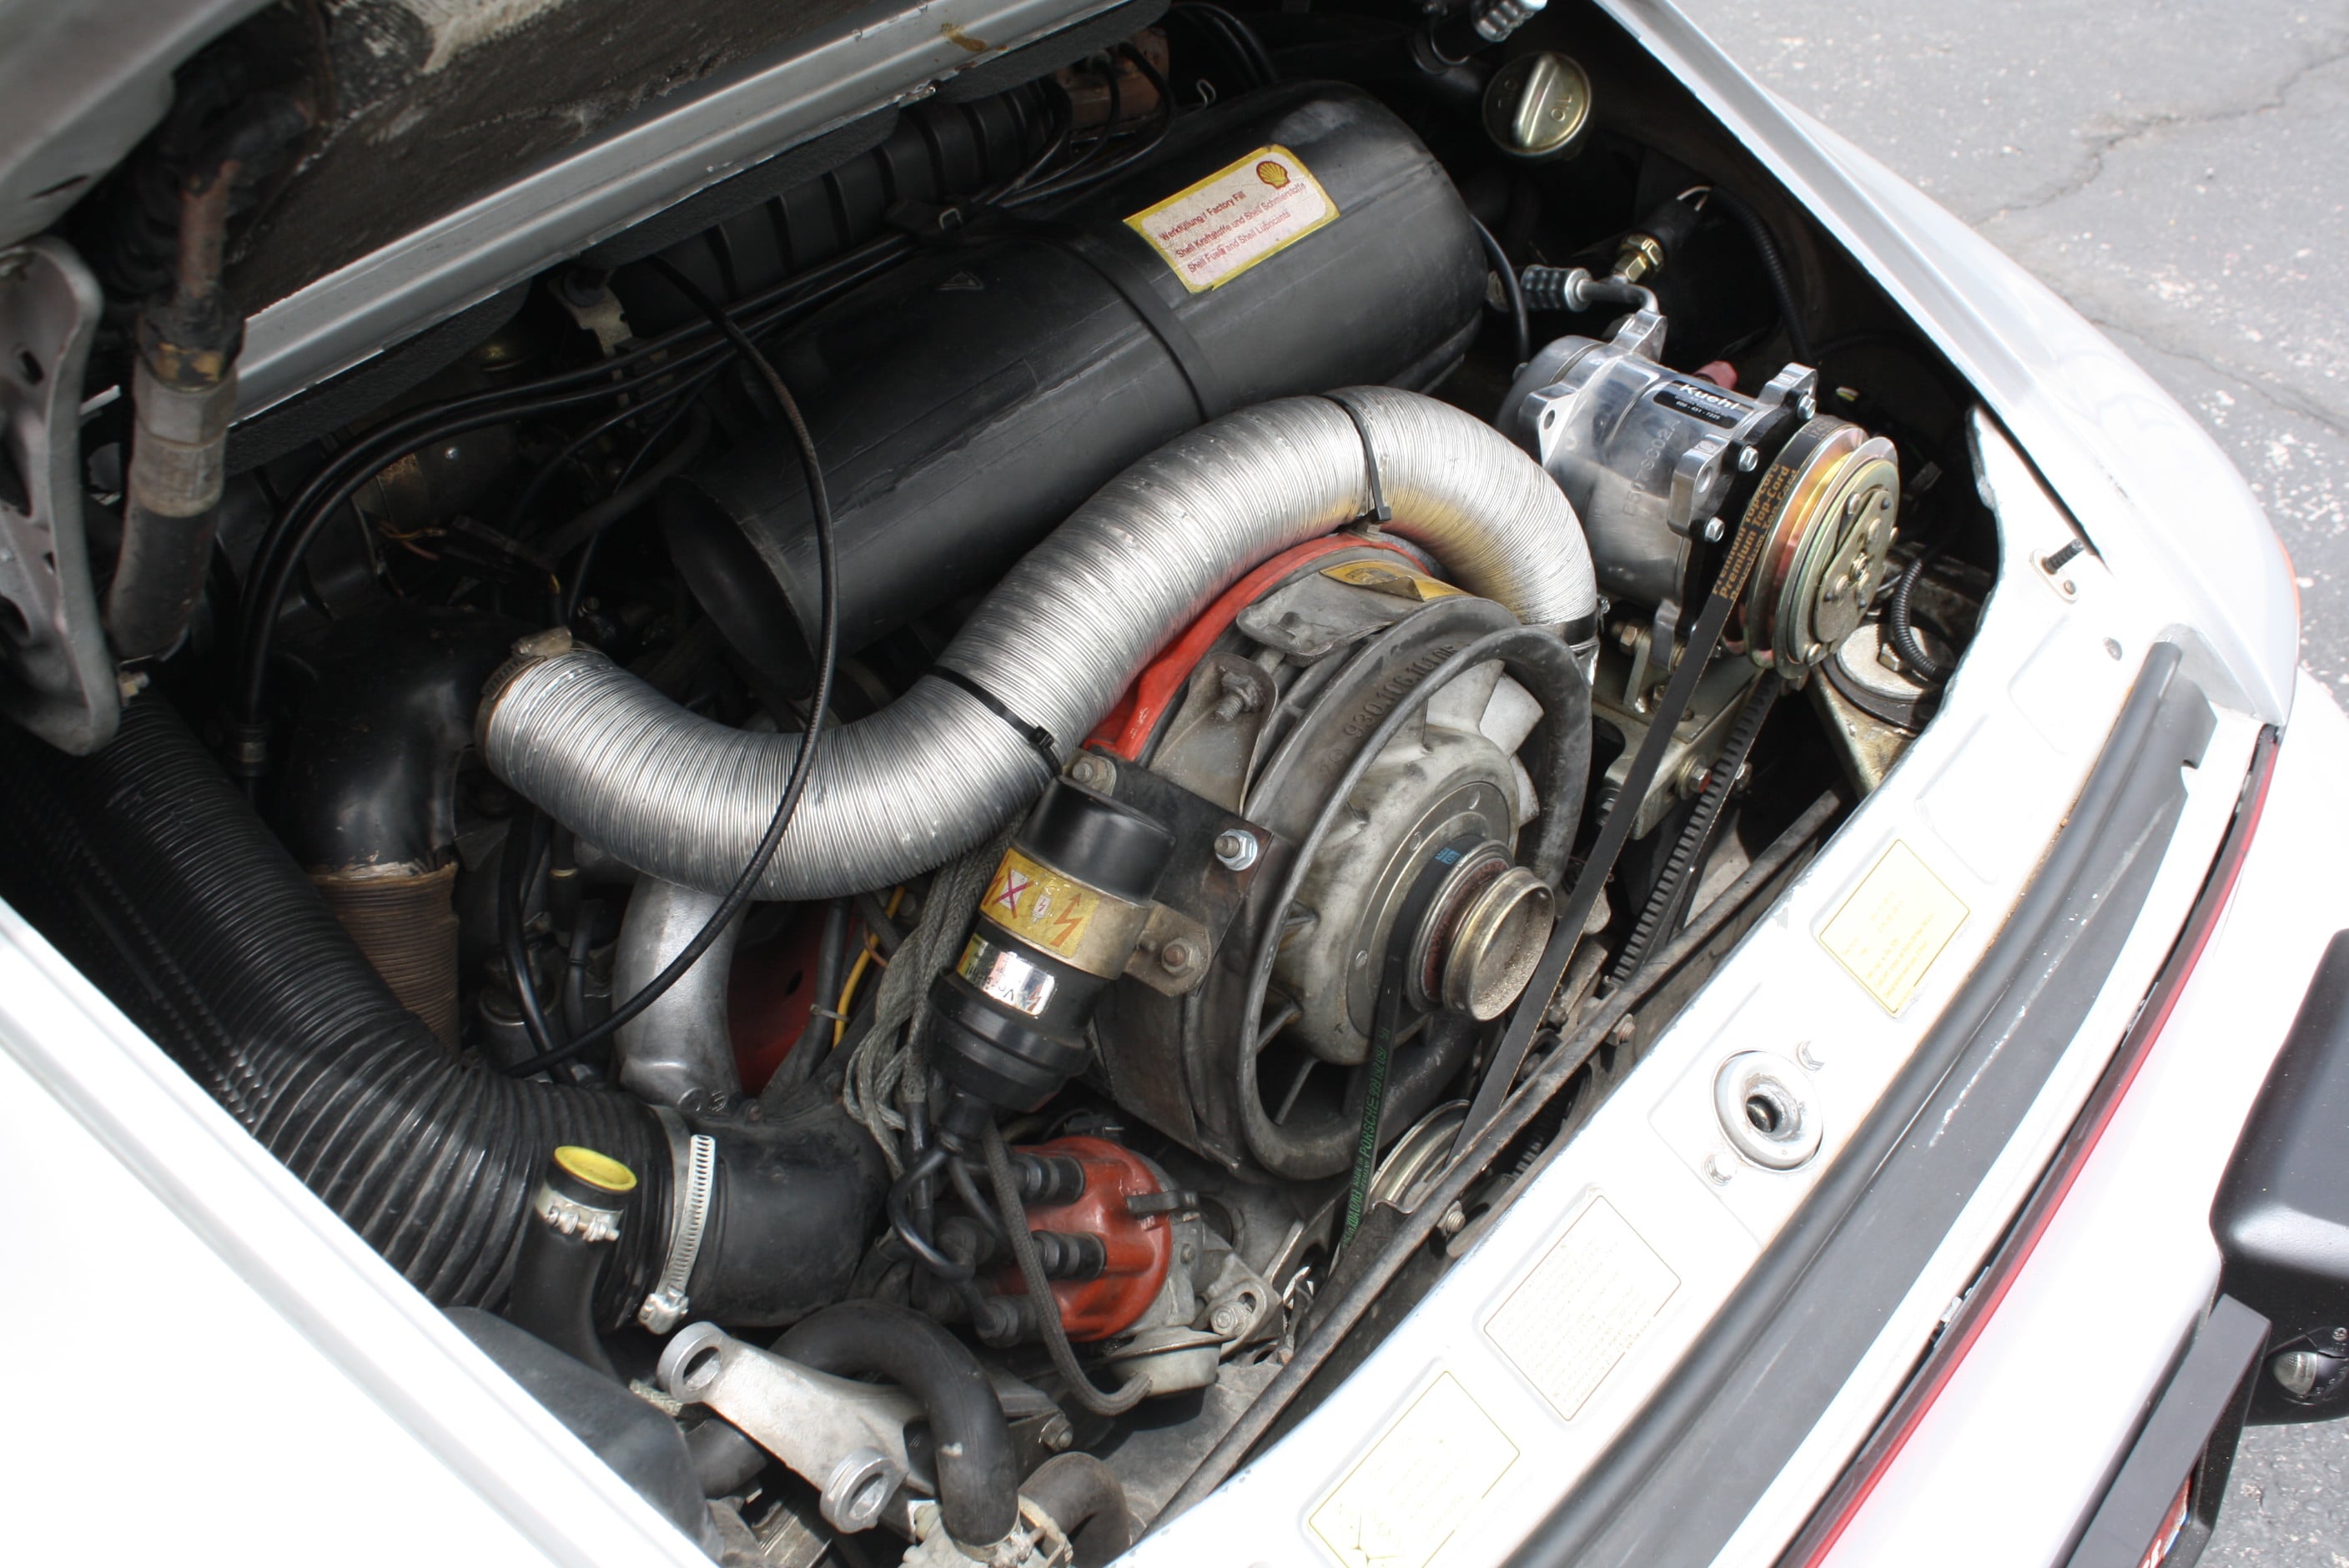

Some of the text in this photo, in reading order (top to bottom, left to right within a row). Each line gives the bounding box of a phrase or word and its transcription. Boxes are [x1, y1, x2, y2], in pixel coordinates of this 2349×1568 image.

[1551, 93, 1572, 122] OIL
[1159, 215, 1205, 240] Werkfüllung
[1206, 199, 1235, 215] Factory
[1232, 191, 1246, 202] Fill
[1175, 182, 1307, 258] Shell Kraftstoffe und Shell Schmierstoffe
[1187, 258, 1207, 273] Shell
[1225, 239, 1240, 251] and
[1237, 229, 1257, 244] Shell
[1255, 210, 1290, 234] Lubricants
[1679, 384, 1741, 410] Kuehl
[1719, 465, 1791, 600] Premium Top-Cord
[1359, 1095, 1380, 1158] PORSCHE
